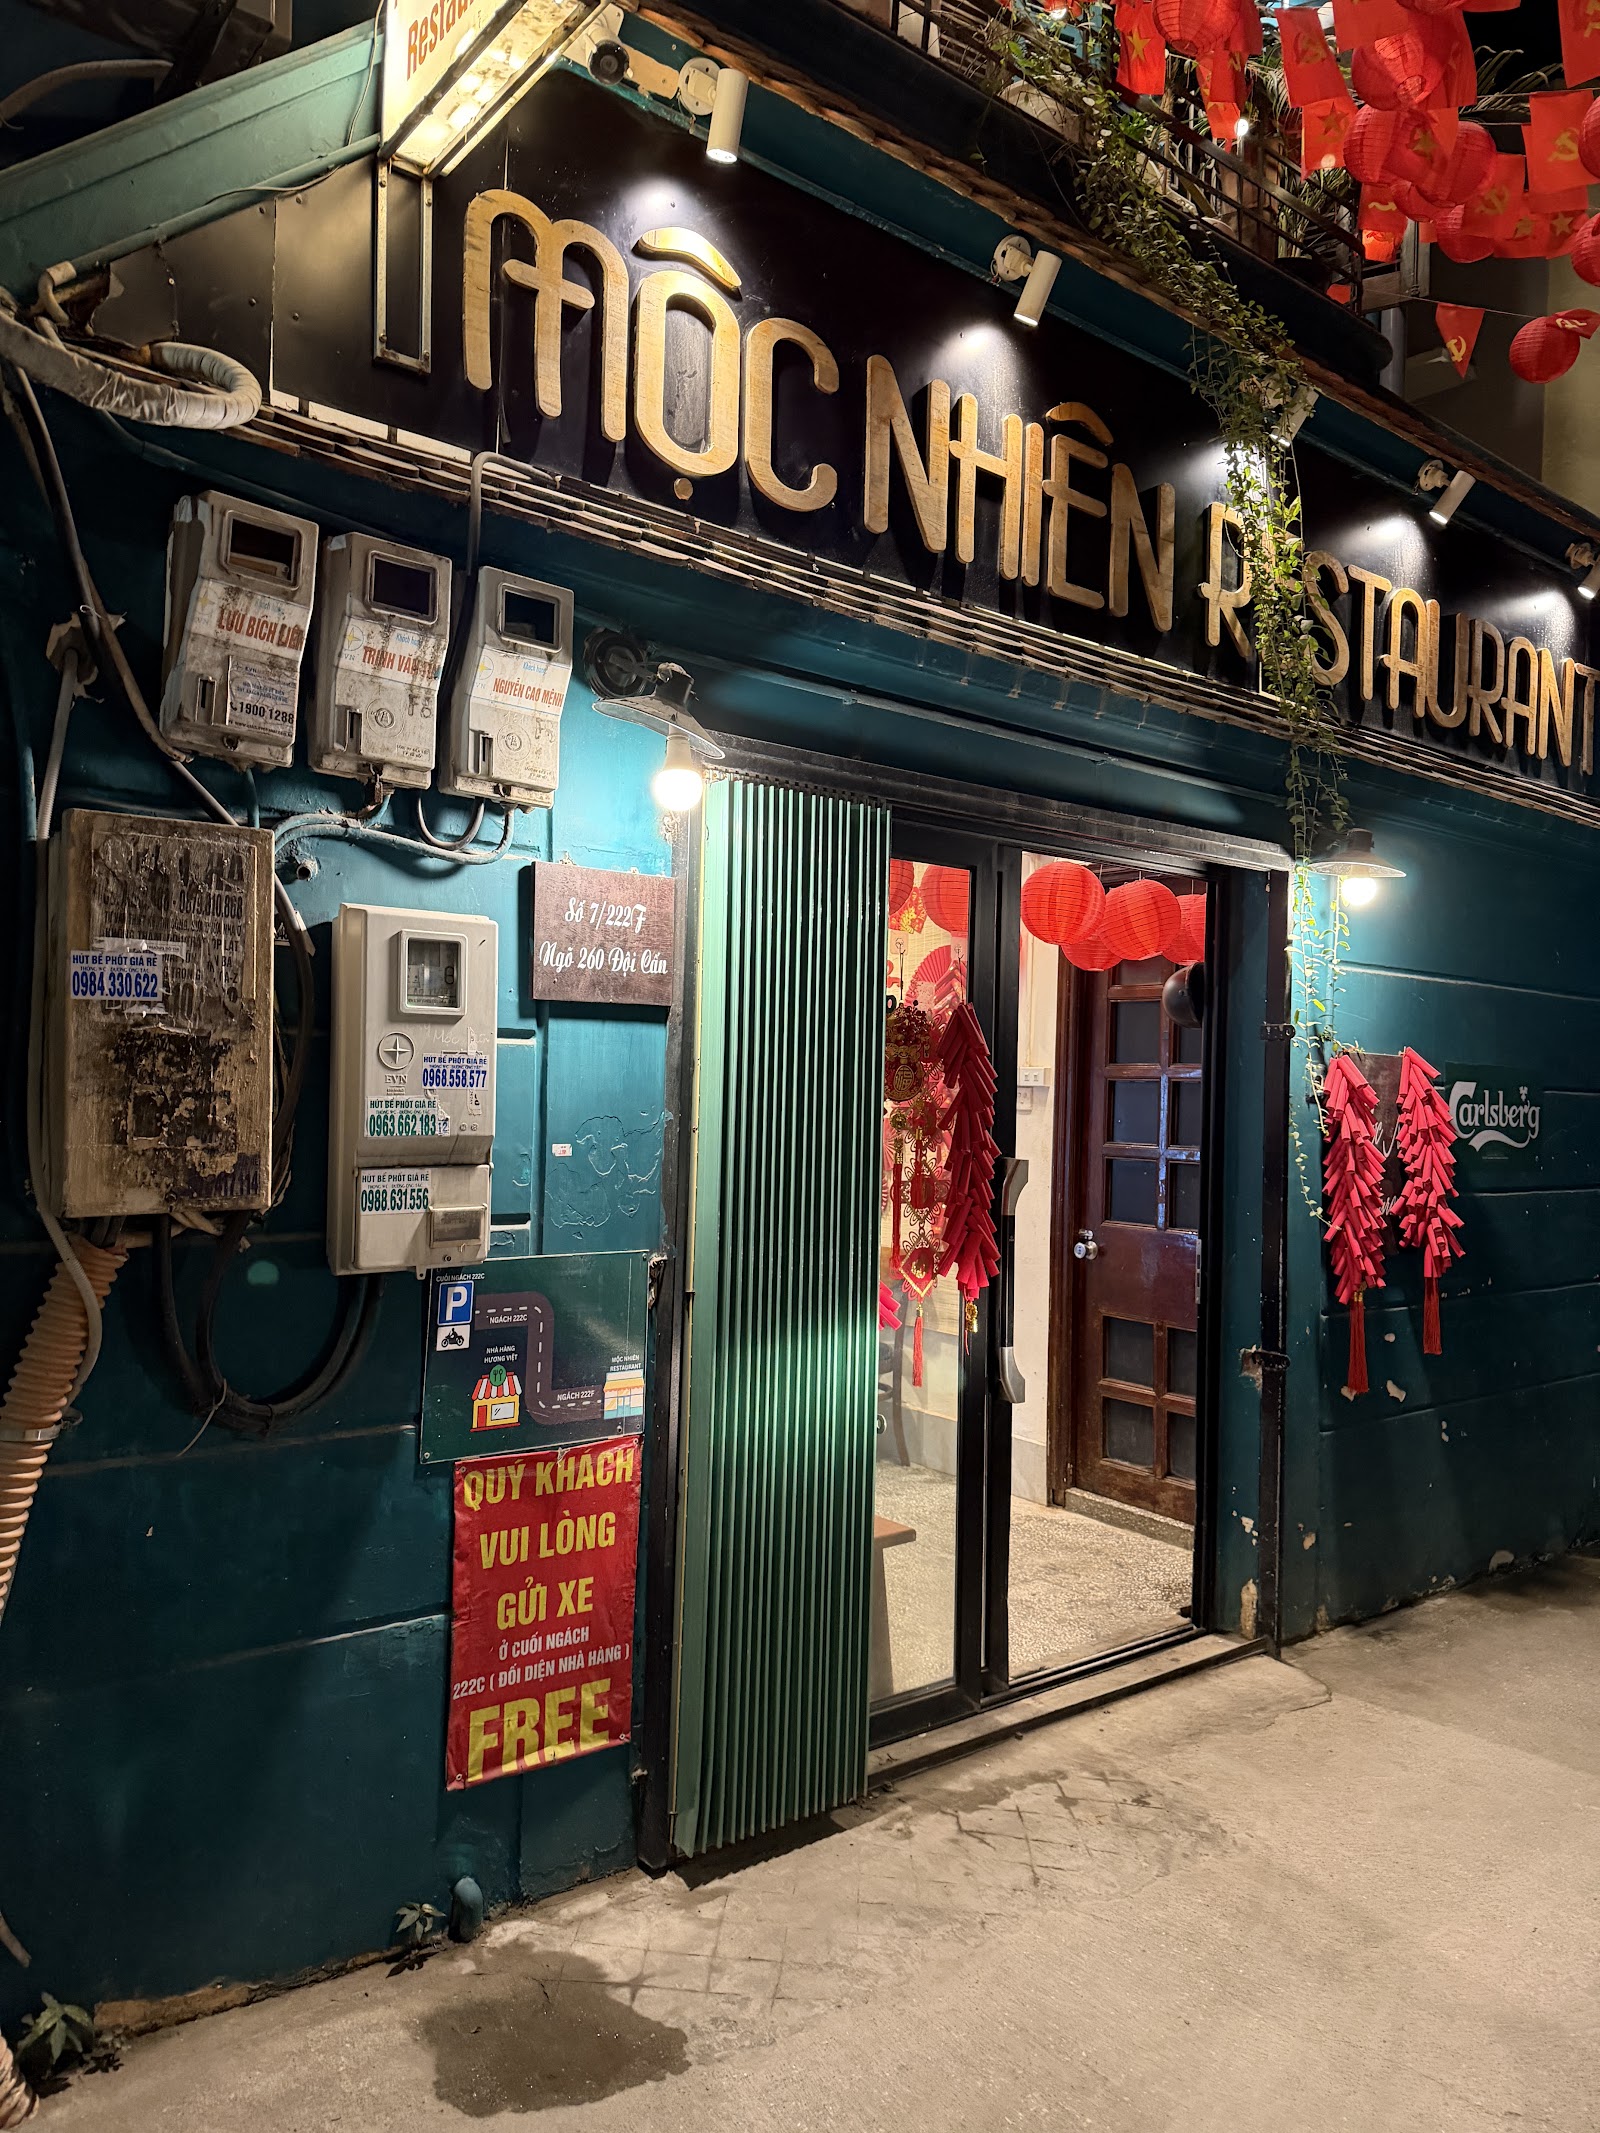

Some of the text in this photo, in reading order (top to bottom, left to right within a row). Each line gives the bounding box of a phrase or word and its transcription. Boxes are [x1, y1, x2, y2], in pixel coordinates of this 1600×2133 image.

[463, 189, 840, 512] MỘC
[864, 354, 1176, 632] NHIÊN
[525, 685, 541, 702] CAO
[239, 702, 295, 724] 1900 1288
[565, 897, 647, 934] Số 7/222F
[72, 953, 89, 964] HÚT
[92, 952, 103, 964] BỂ
[105, 953, 128, 965] PHỐT
[130, 954, 144, 966] GIÁ
[539, 940, 668, 977] Ngõ 260 Đội Cấn
[72, 970, 158, 998] 0984.330.622
[423, 1055, 437, 1063] HÚT
[438, 1055, 447, 1063] BỂ
[448, 1056, 465, 1064] PHỐT
[466, 1056, 477, 1064] GIÁ
[384, 1074, 407, 1085] EVN
[423, 1068, 487, 1088] 0968.558.577
[370, 1098, 383, 1108] HÚT
[385, 1097, 394, 1108] BỂ
[395, 1098, 413, 1108] PHỐT
[415, 1098, 426, 1108] GIÁ
[1449, 1081, 1541, 1143] Carlsberg
[369, 1114, 436, 1136] 0963.662.183
[362, 1173, 375, 1182] HÚT
[377, 1172, 387, 1182] BỂ
[388, 1172, 405, 1182] PHỐT
[407, 1172, 418, 1181] GIÁ
[361, 1188, 429, 1212] 0988.631.556
[446, 1286, 468, 1321] P
[489, 1314, 528, 1324] NGÁCH 222C
[486, 1345, 516, 1354] NHÀ HÀNG
[609, 1363, 642, 1372] RESTAURANT
[557, 1390, 595, 1401] NGÁCH 222F
[463, 1447, 635, 1512] QUÝ KHÁCH
[480, 1510, 616, 1570] VUI LÒNG
[496, 1576, 594, 1630] GỬI XE
[499, 1626, 590, 1661] Ở CUỐI NGÁCH
[453, 1678, 486, 1700] 222C
[498, 1664, 521, 1688] ĐỐI
[525, 1659, 555, 1683] DIỆN
[558, 1650, 585, 1674] NHÀ
[588, 1644, 622, 1667] HÀNG
[467, 1677, 611, 1783] FREE
